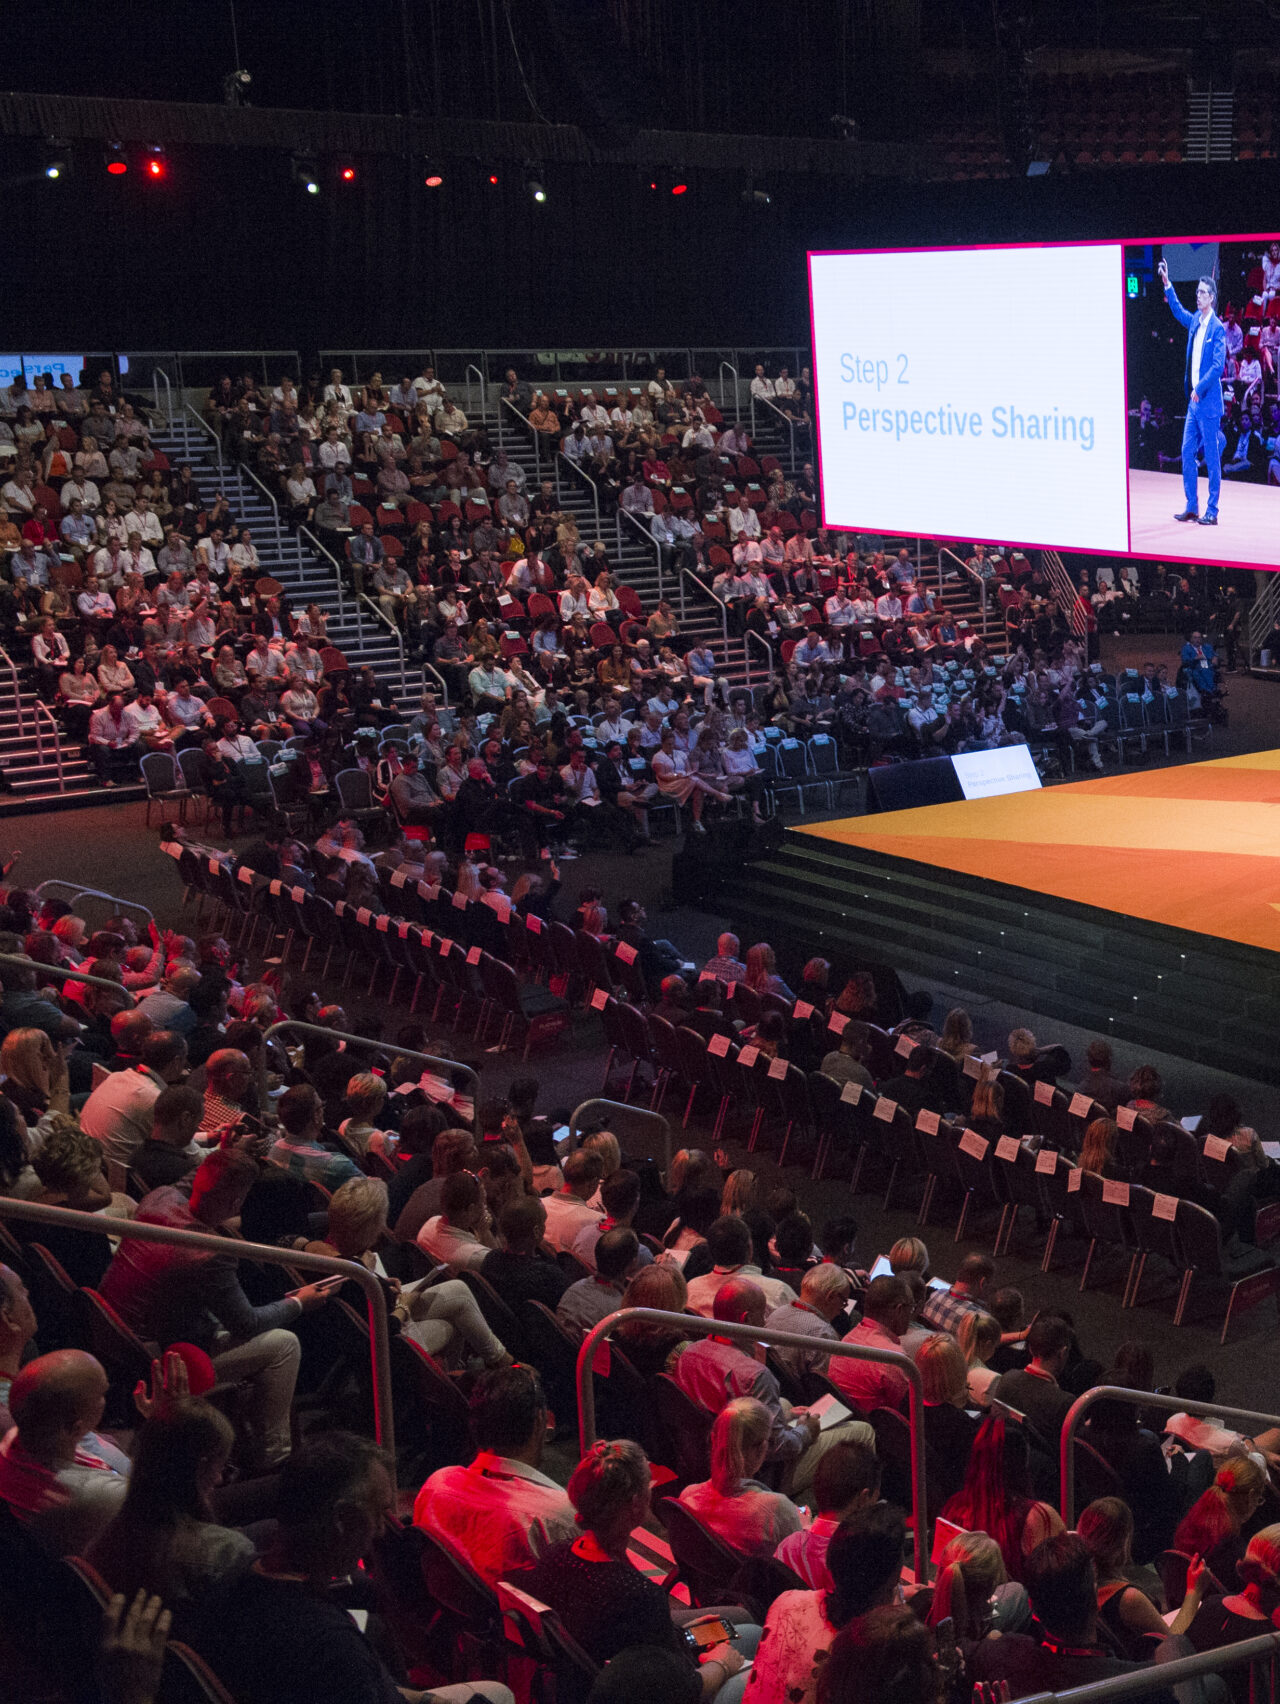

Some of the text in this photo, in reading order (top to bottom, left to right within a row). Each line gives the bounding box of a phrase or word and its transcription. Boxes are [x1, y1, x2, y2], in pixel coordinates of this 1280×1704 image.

[840, 353, 910, 393] Step 2
[842, 401, 1095, 452] Perspective Sharing
